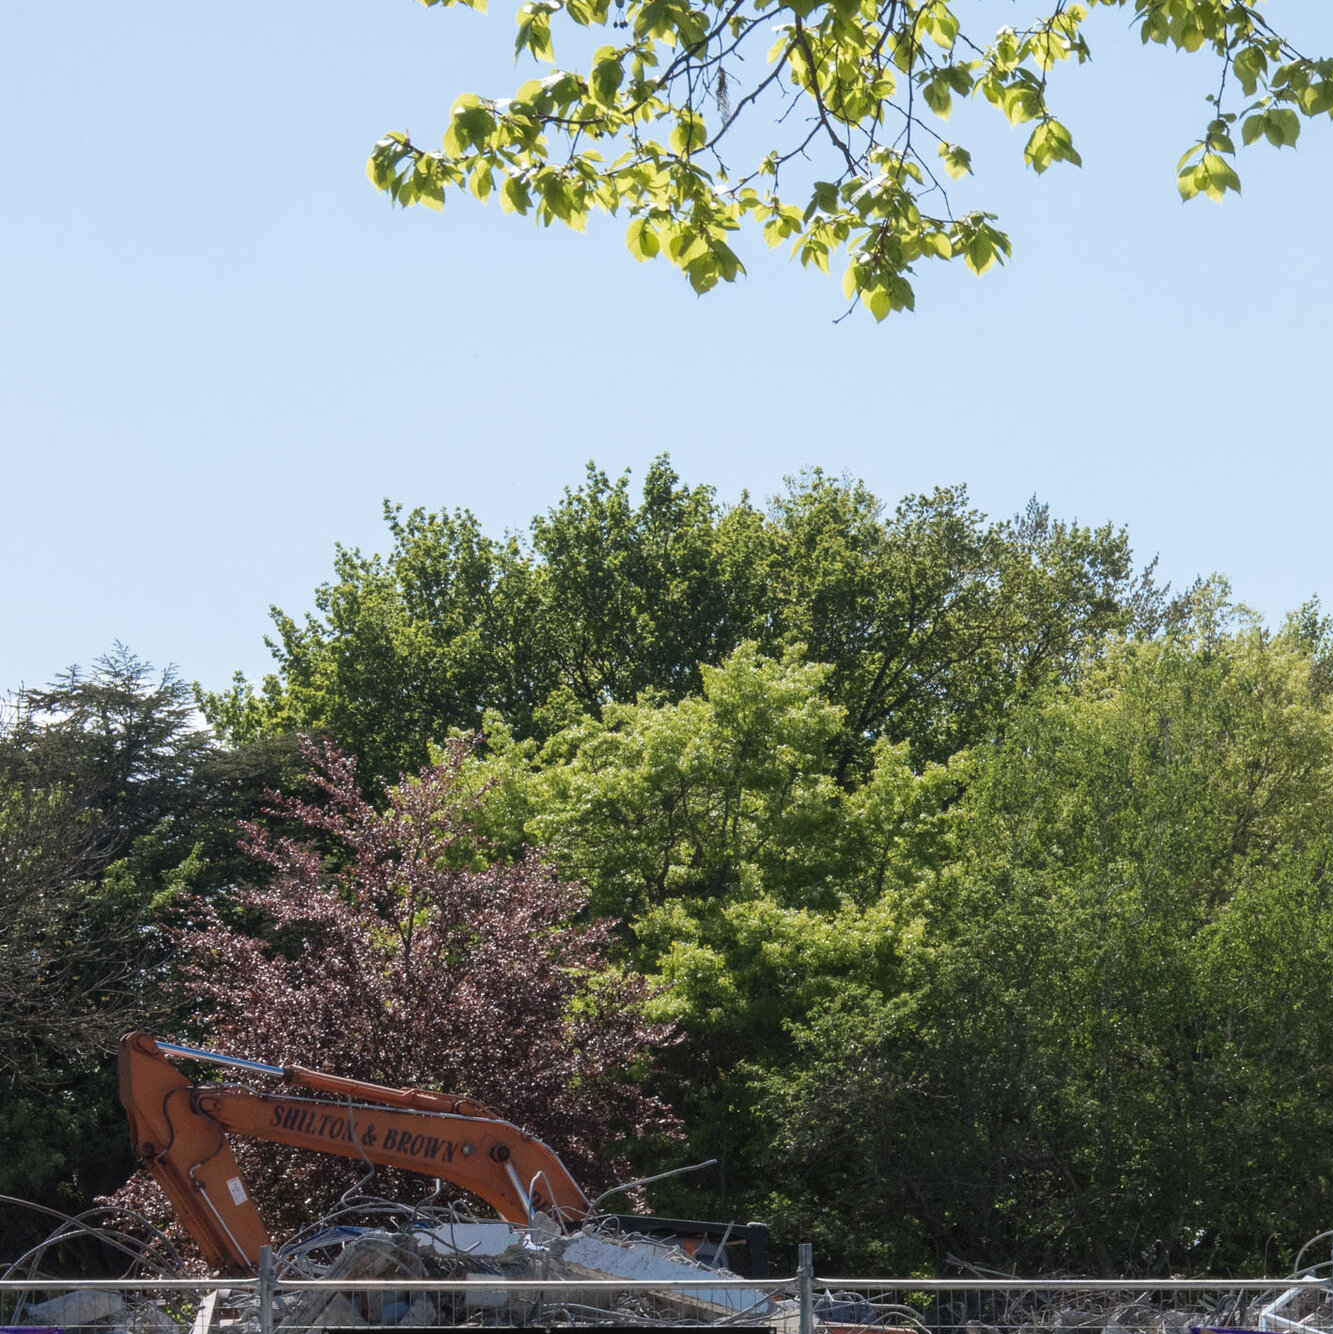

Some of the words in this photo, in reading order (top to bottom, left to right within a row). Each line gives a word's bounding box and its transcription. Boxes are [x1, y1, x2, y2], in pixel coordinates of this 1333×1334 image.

[270, 1104, 358, 1143] SHILTON
[361, 1124, 377, 1147] &
[383, 1127, 459, 1163] BROWN
